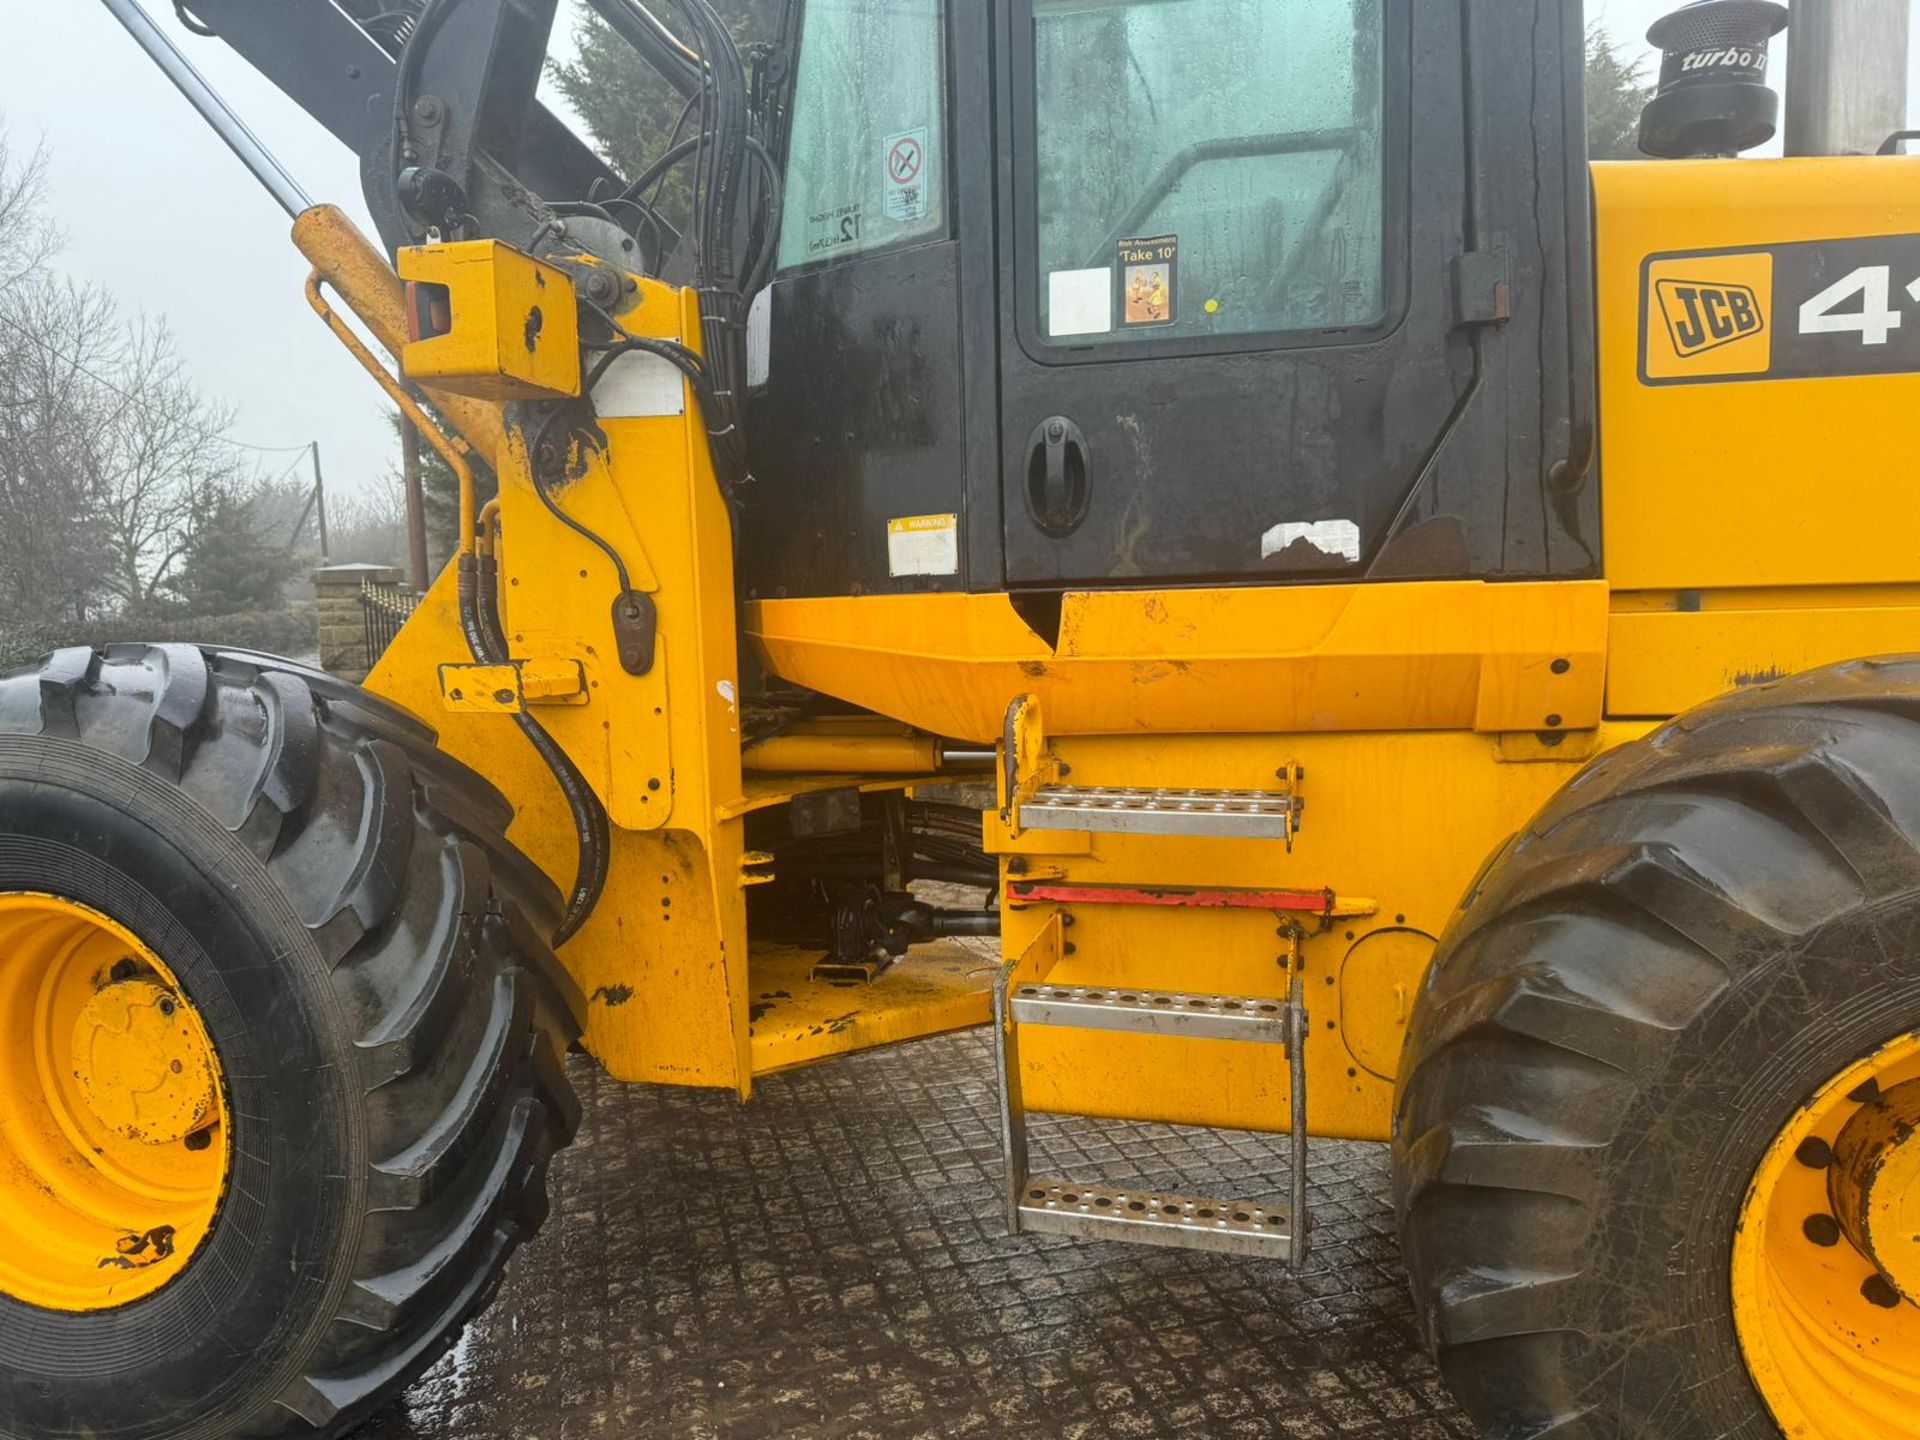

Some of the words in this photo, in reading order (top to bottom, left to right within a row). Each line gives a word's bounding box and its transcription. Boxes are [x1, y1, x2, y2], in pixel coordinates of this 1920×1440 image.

[1682, 47, 1751, 71] turbo
[1674, 287, 1756, 349] JCB
[909, 517, 946, 529] WARNING
